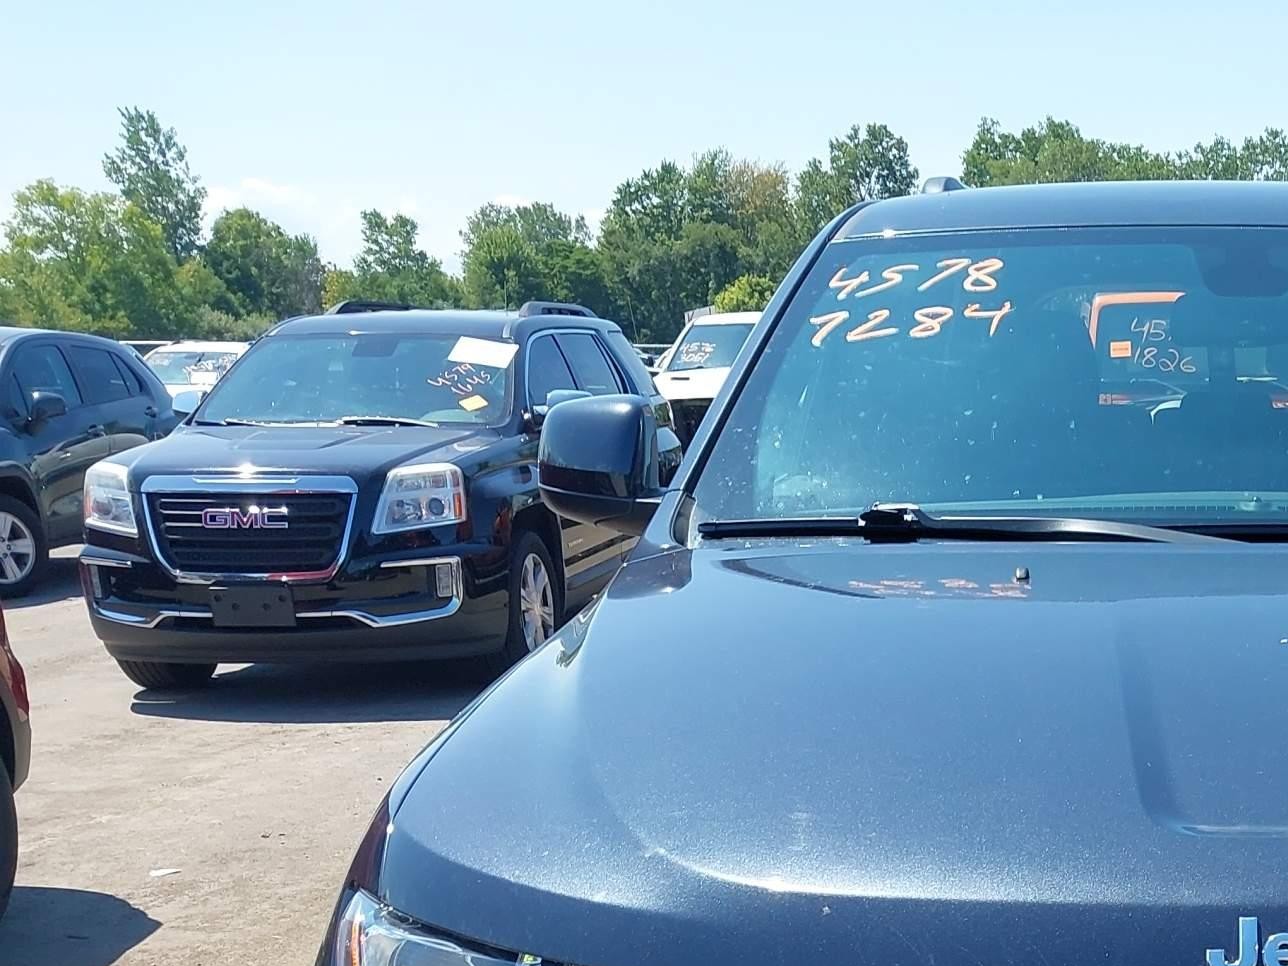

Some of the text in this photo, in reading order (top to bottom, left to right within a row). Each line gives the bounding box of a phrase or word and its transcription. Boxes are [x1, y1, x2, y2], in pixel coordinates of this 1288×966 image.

[829, 258, 1003, 300] 4578
[810, 301, 1012, 347] 7284
[1134, 347, 1196, 373] 1826
[202, 505, 289, 529] GMC
